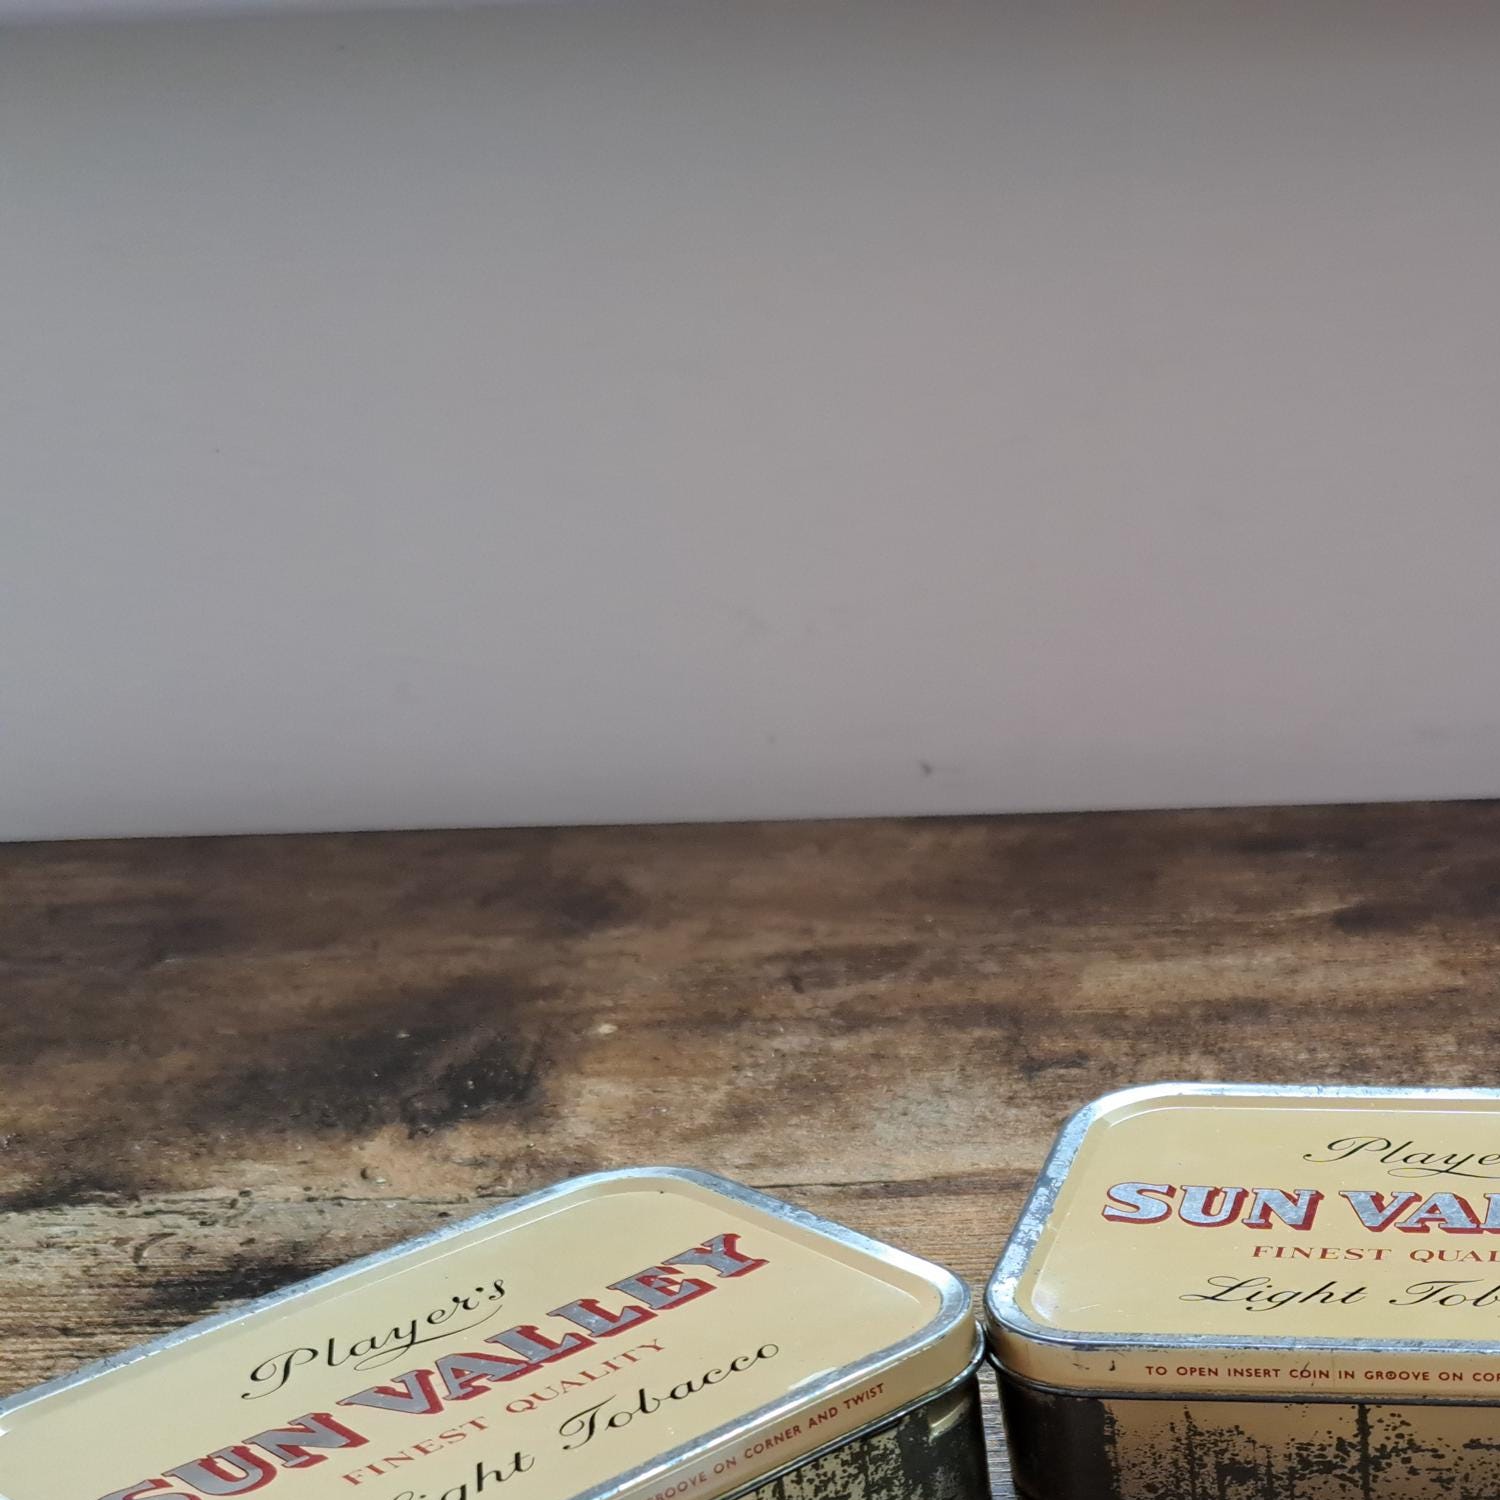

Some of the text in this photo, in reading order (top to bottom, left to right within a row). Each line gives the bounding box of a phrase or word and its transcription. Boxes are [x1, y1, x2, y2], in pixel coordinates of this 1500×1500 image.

[1101, 1181, 1326, 1231] SUN
[1178, 1275, 1368, 1312] Light
[1251, 1245, 1393, 1261] FINEST
[241, 1278, 507, 1400] Player's
[335, 1233, 770, 1415] VALLEY
[341, 1338, 667, 1487] FINEST QUALITY
[558, 1343, 780, 1452] Tobacco
[1145, 1366, 1168, 1376] TO
[1176, 1366, 1219, 1377] OPEN
[1227, 1368, 1281, 1379] INSERT
[1289, 1368, 1330, 1379] COIN
[1338, 1369, 1355, 1380] IN
[1364, 1370, 1430, 1381] GROOVE
[1438, 1371, 1463, 1382] ON
[713, 1456, 737, 1474] ON
[744, 1424, 802, 1460] CORNER
[808, 1406, 839, 1430] AND
[842, 1382, 885, 1411] TWIST
